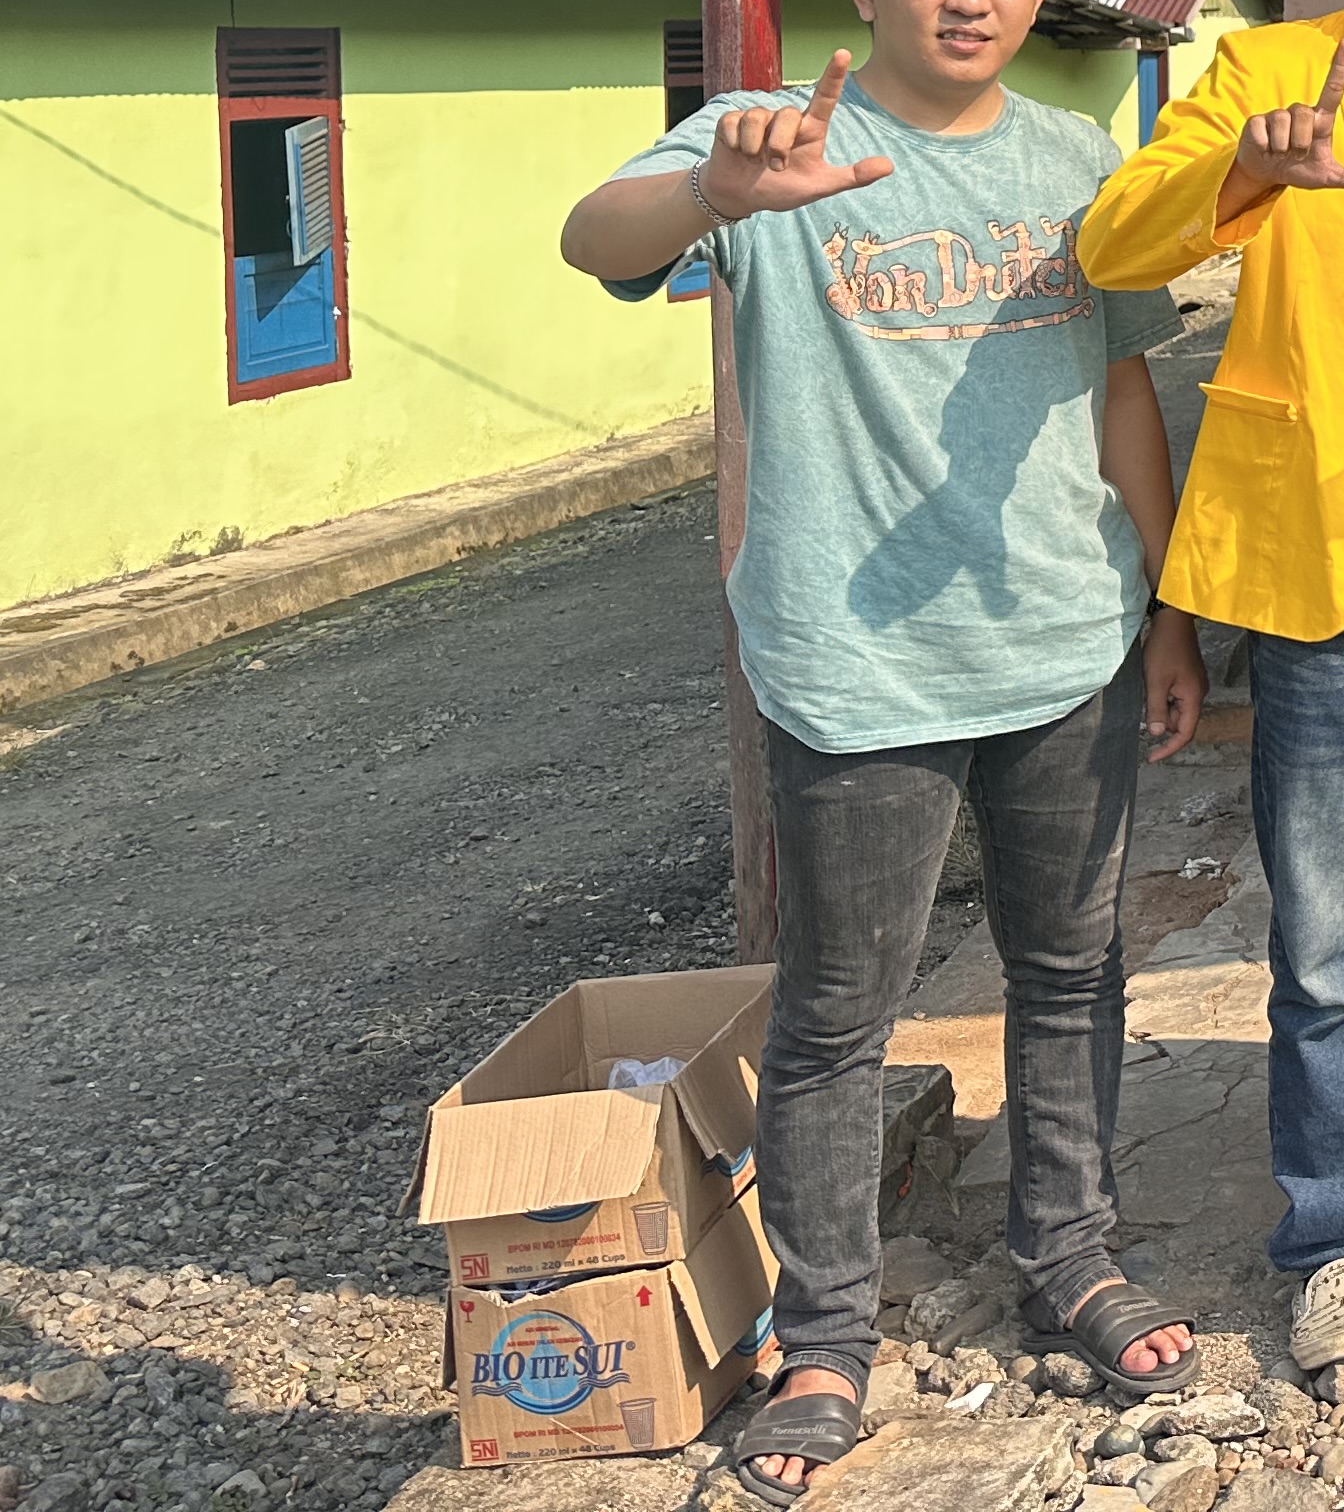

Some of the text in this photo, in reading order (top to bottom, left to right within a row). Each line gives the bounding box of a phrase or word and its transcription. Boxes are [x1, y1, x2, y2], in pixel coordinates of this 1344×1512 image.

[460, 1253, 490, 1280] SNI
[542, 1259, 562, 1270] 220
[586, 1255, 599, 1265] 48
[471, 1340, 627, 1384] BIO ITE SUI
[469, 1439, 500, 1462] SNI
[539, 1447, 557, 1458] 220
